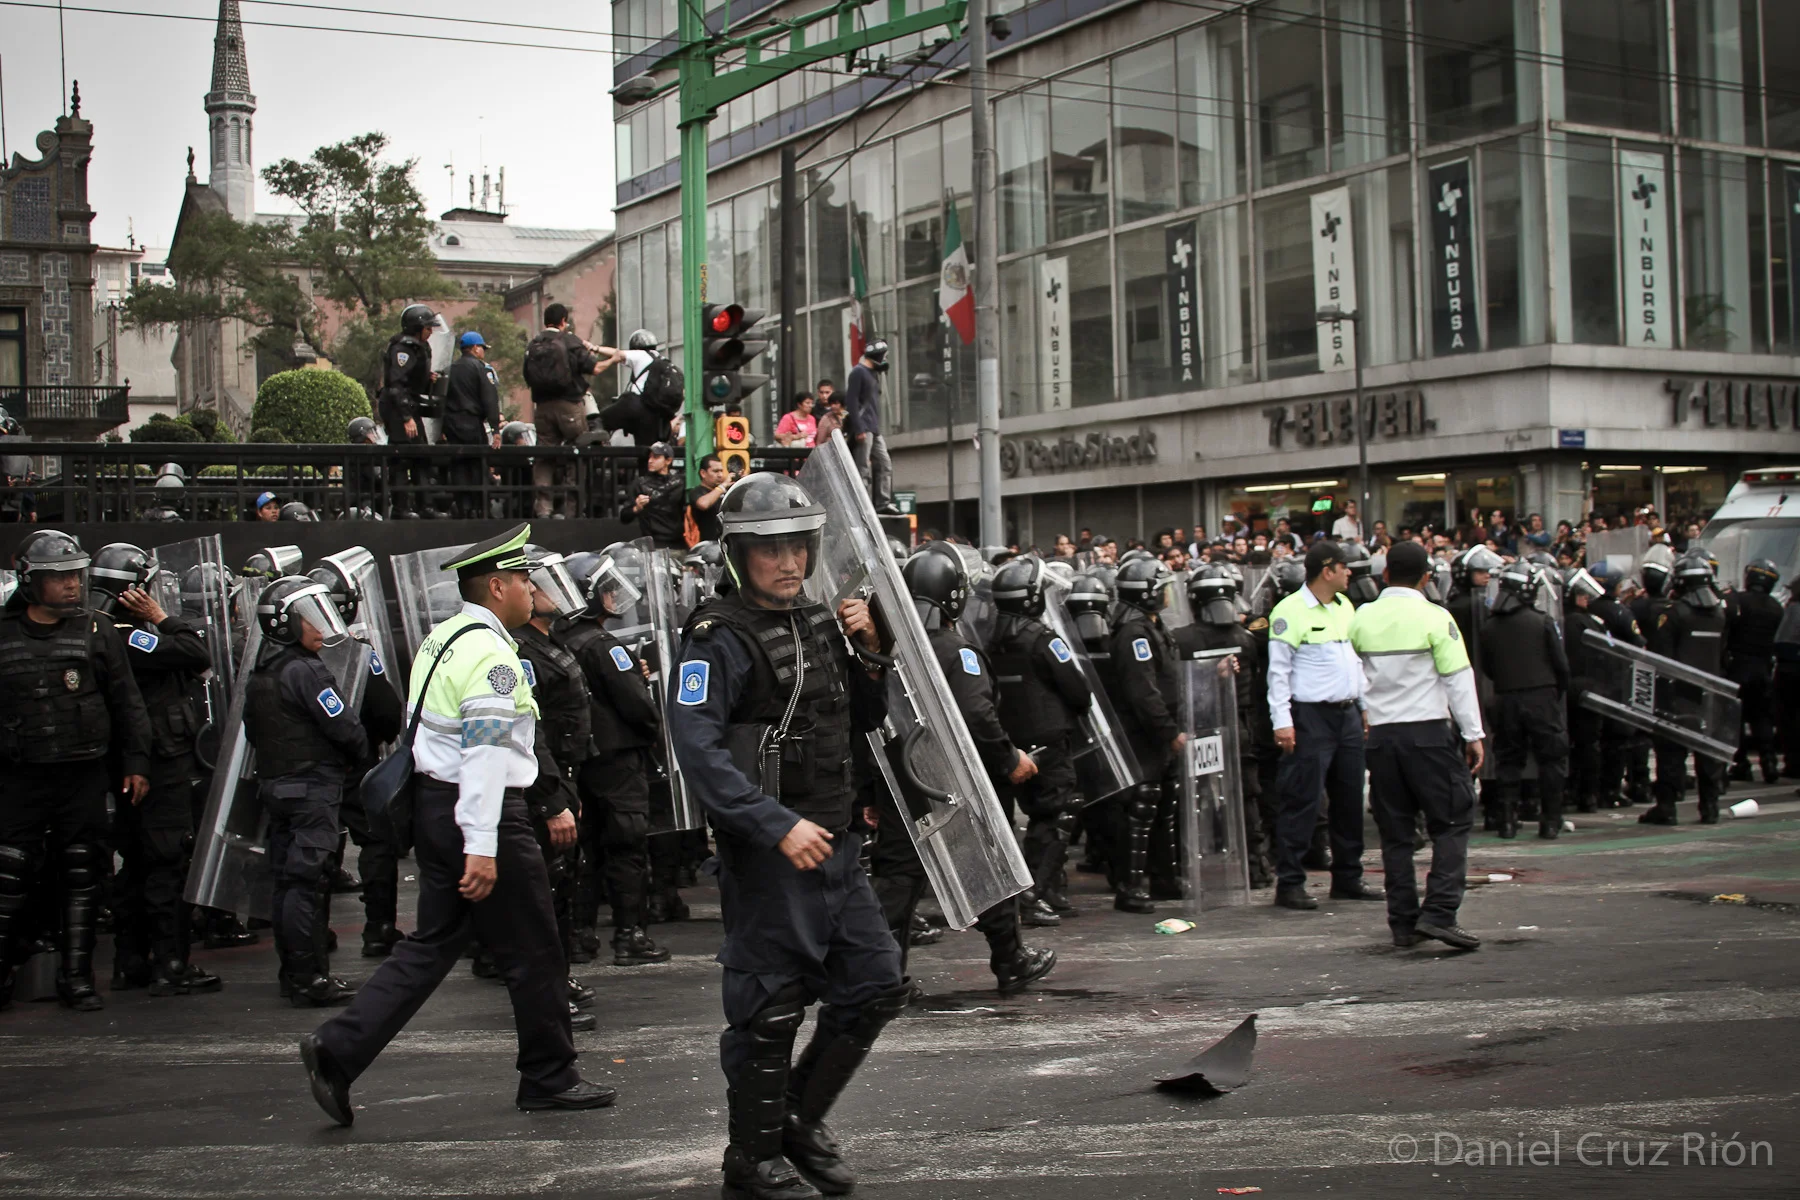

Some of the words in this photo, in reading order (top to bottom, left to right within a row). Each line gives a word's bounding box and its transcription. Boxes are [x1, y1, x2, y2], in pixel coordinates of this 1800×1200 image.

[1178, 275, 1193, 381] INBURSA
[1328, 251, 1344, 366] INBRSA
[1445, 225, 1464, 348] INBURSA
[1640, 218, 1656, 342] INBURSA
[1050, 310, 1061, 408] INBURSA
[421, 637, 454, 664] RANSO
